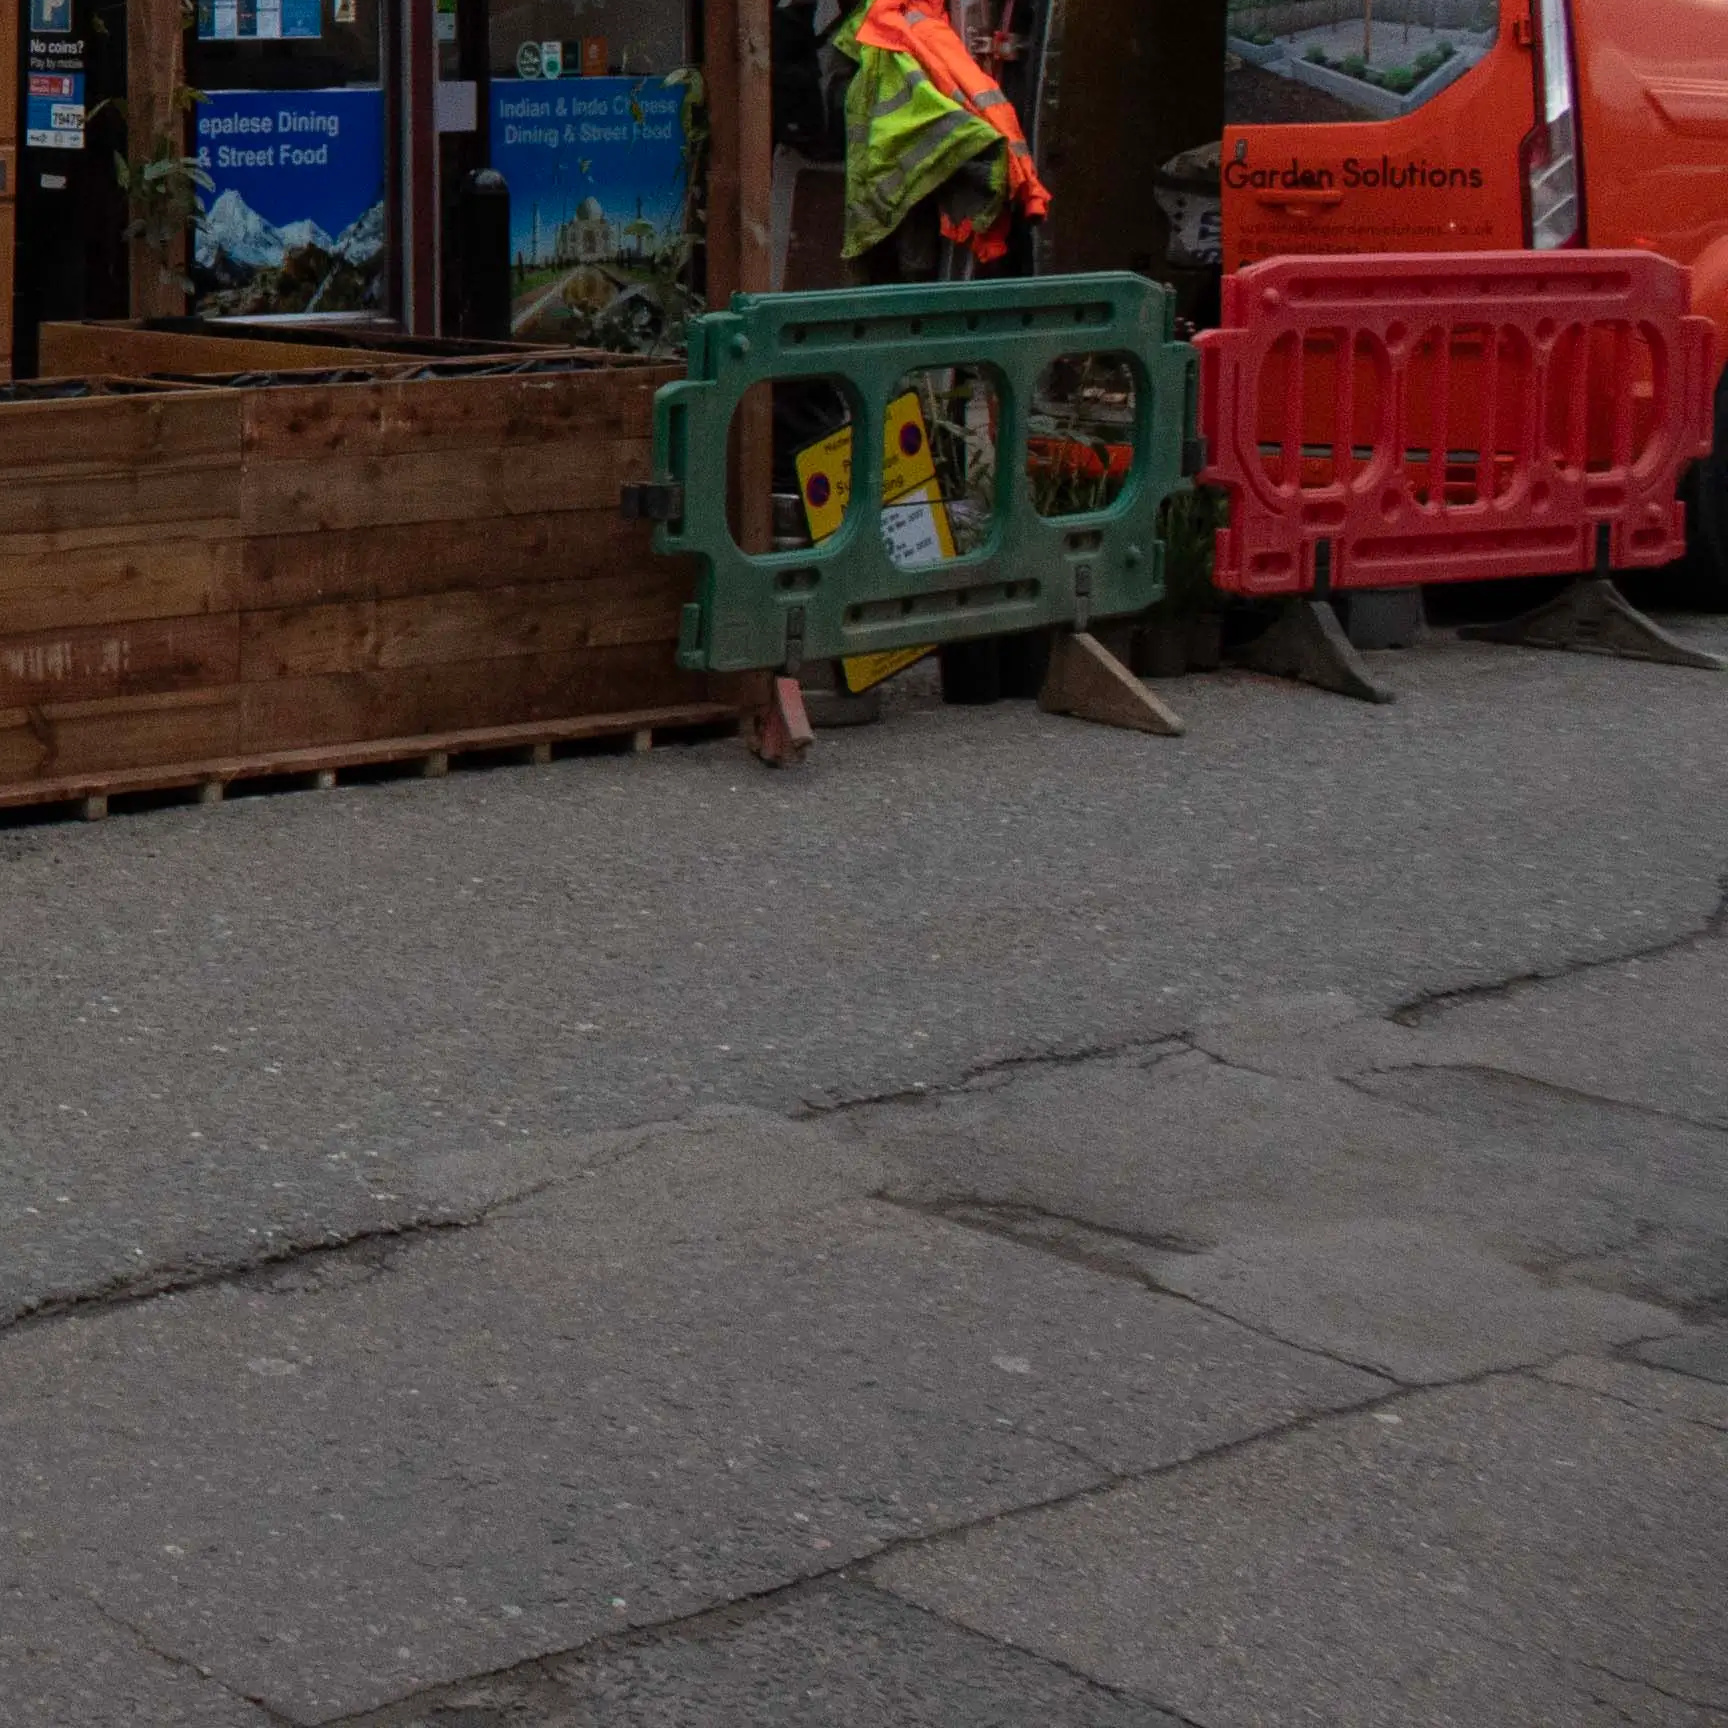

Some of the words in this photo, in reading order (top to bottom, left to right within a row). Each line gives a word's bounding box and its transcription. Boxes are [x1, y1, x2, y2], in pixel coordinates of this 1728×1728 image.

[30, 39, 45, 54] No
[48, 39, 85, 55] coins?
[499, 97, 552, 119] Indian
[555, 95, 568, 117] &
[198, 111, 274, 139] epalese
[277, 110, 341, 138] Dining
[504, 123, 561, 149] Dining
[198, 145, 212, 168] &
[216, 144, 275, 168] Street
[279, 143, 329, 166] Food
[1224, 158, 1334, 189] Garden
[1342, 155, 1484, 189] Solutions
